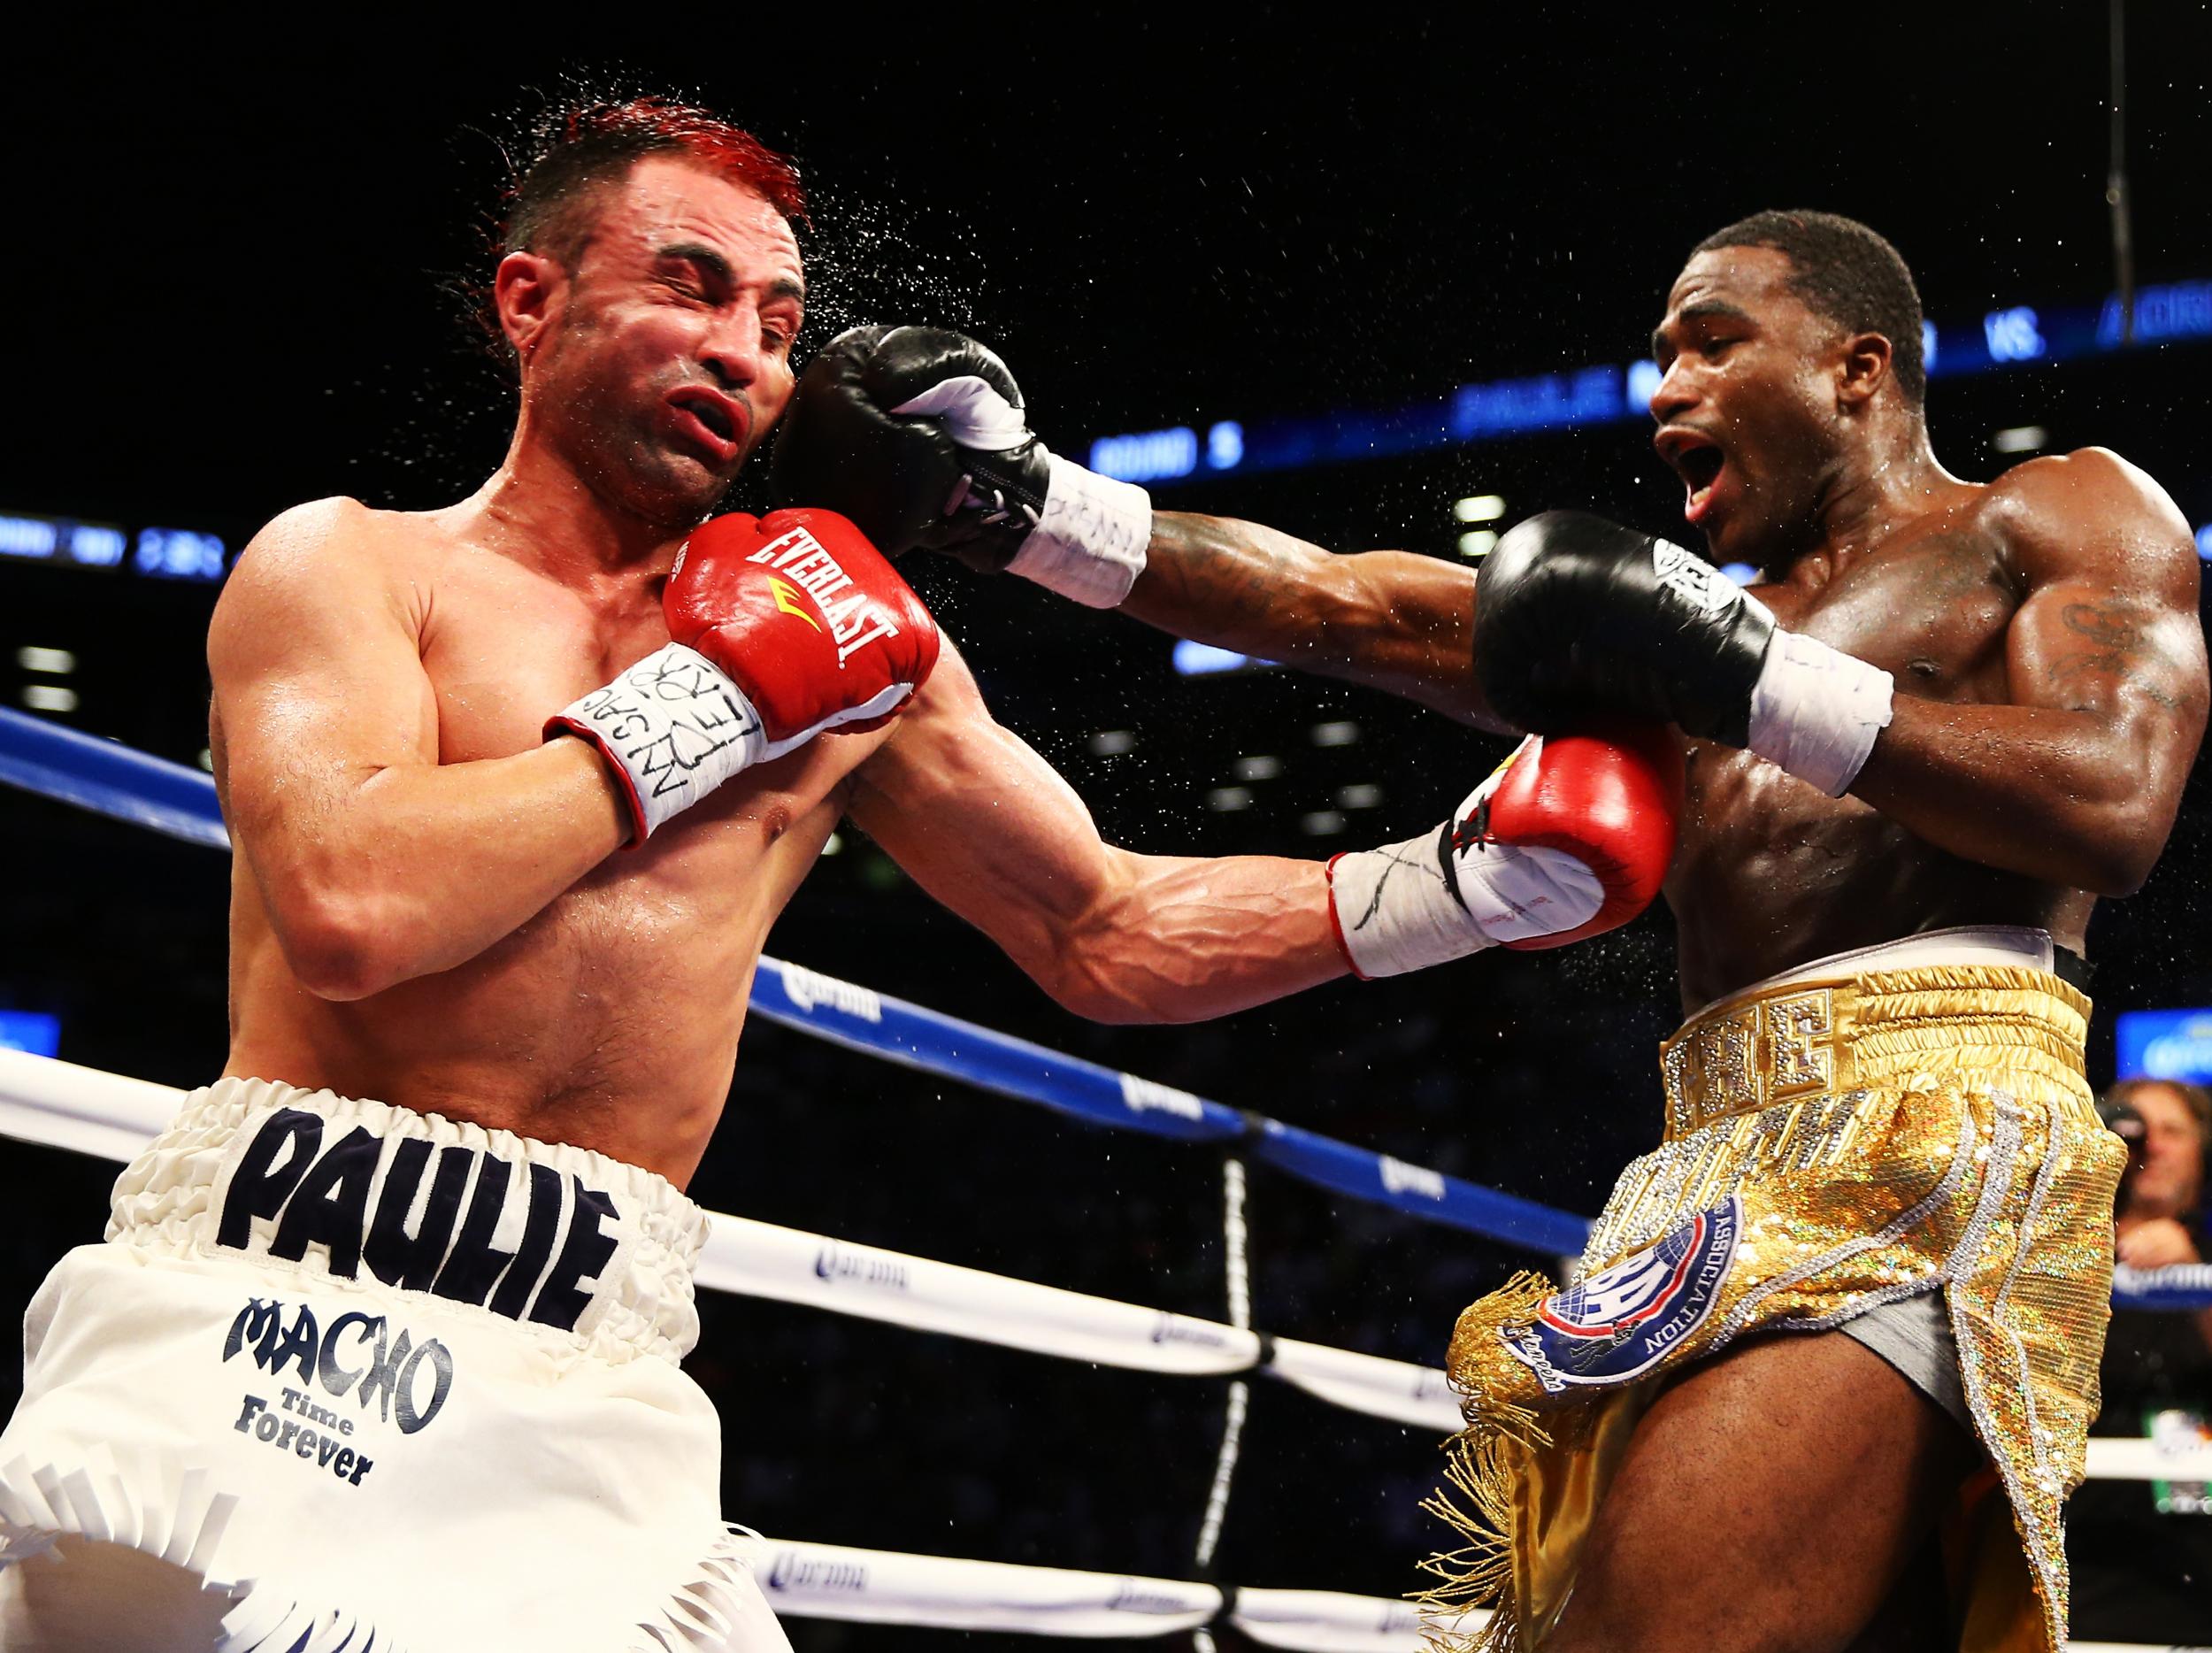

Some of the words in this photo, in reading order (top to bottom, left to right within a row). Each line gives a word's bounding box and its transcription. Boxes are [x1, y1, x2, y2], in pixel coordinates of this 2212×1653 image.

[216, 1107, 620, 1333] PAULIE
[1647, 1216, 1732, 1355] ASSOCIATION
[234, 1395, 373, 1487] Forever
[281, 1387, 355, 1436] Time
